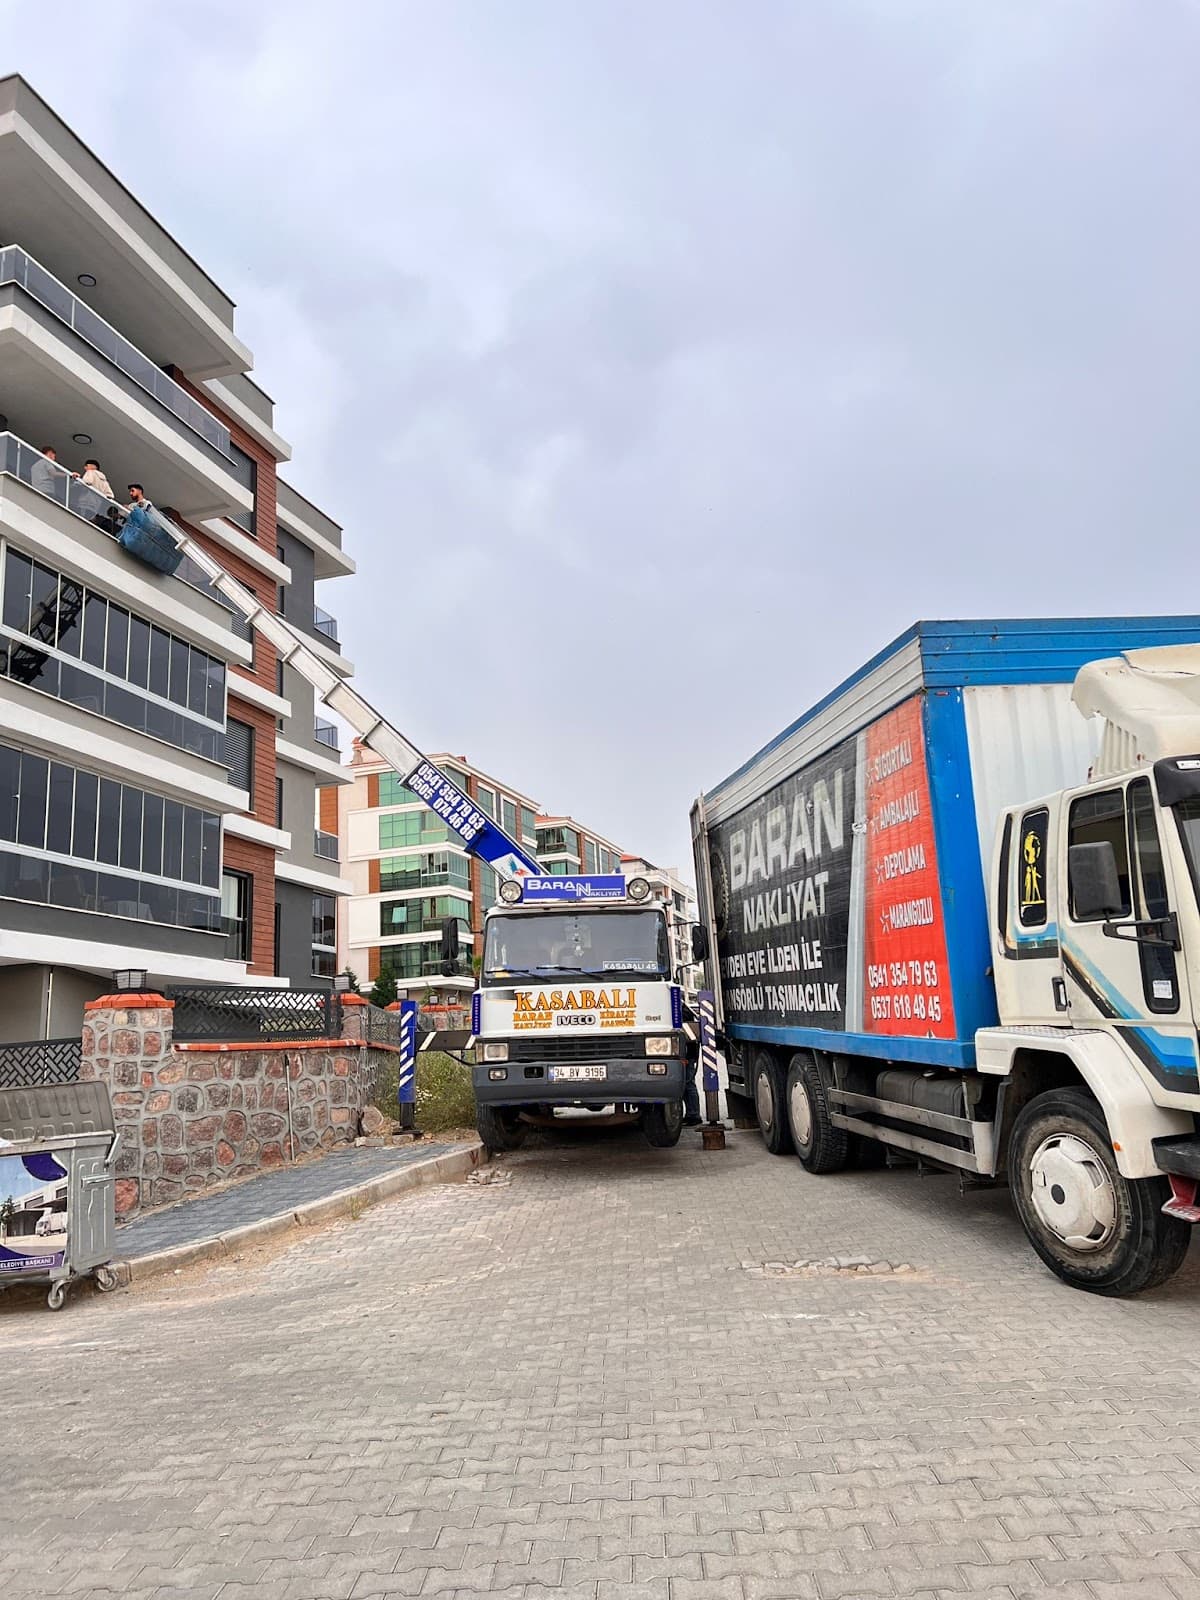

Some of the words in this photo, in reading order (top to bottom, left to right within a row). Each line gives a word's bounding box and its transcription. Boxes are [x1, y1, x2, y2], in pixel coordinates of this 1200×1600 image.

[408, 774, 435, 800] 0505
[433, 799, 453, 818] 074
[448, 813, 464, 829] 46
[460, 823, 477, 841] 86
[418, 763, 441, 790] 0541
[439, 784, 458, 807] 354
[456, 800, 472, 818] 79
[469, 811, 486, 829] 63
[730, 768, 844, 892] BARAN
[884, 843, 926, 880] DEPOLAMA
[743, 871, 829, 934] NAKLİYAT
[889, 896, 934, 929] MARANGOZLU
[747, 950, 766, 976] EVE
[767, 942, 800, 973] İLDEN
[801, 936, 822, 970] İLE
[868, 964, 888, 988] 0541
[890, 961, 908, 987] 354
[909, 960, 922, 986] 79
[924, 960, 938, 987] 63
[514, 989, 637, 1011] KASABALI
[724, 981, 764, 1012] ANSÖRLÜ
[765, 983, 841, 1018] TAŞIMACILIK
[871, 995, 891, 1019] 0537
[894, 994, 911, 1019] 618
[914, 994, 926, 1019] 48
[928, 995, 942, 1022] 45
[557, 1015, 596, 1026] IVECO
[555, 1068, 564, 1077] 34
[570, 1067, 579, 1078] BV
